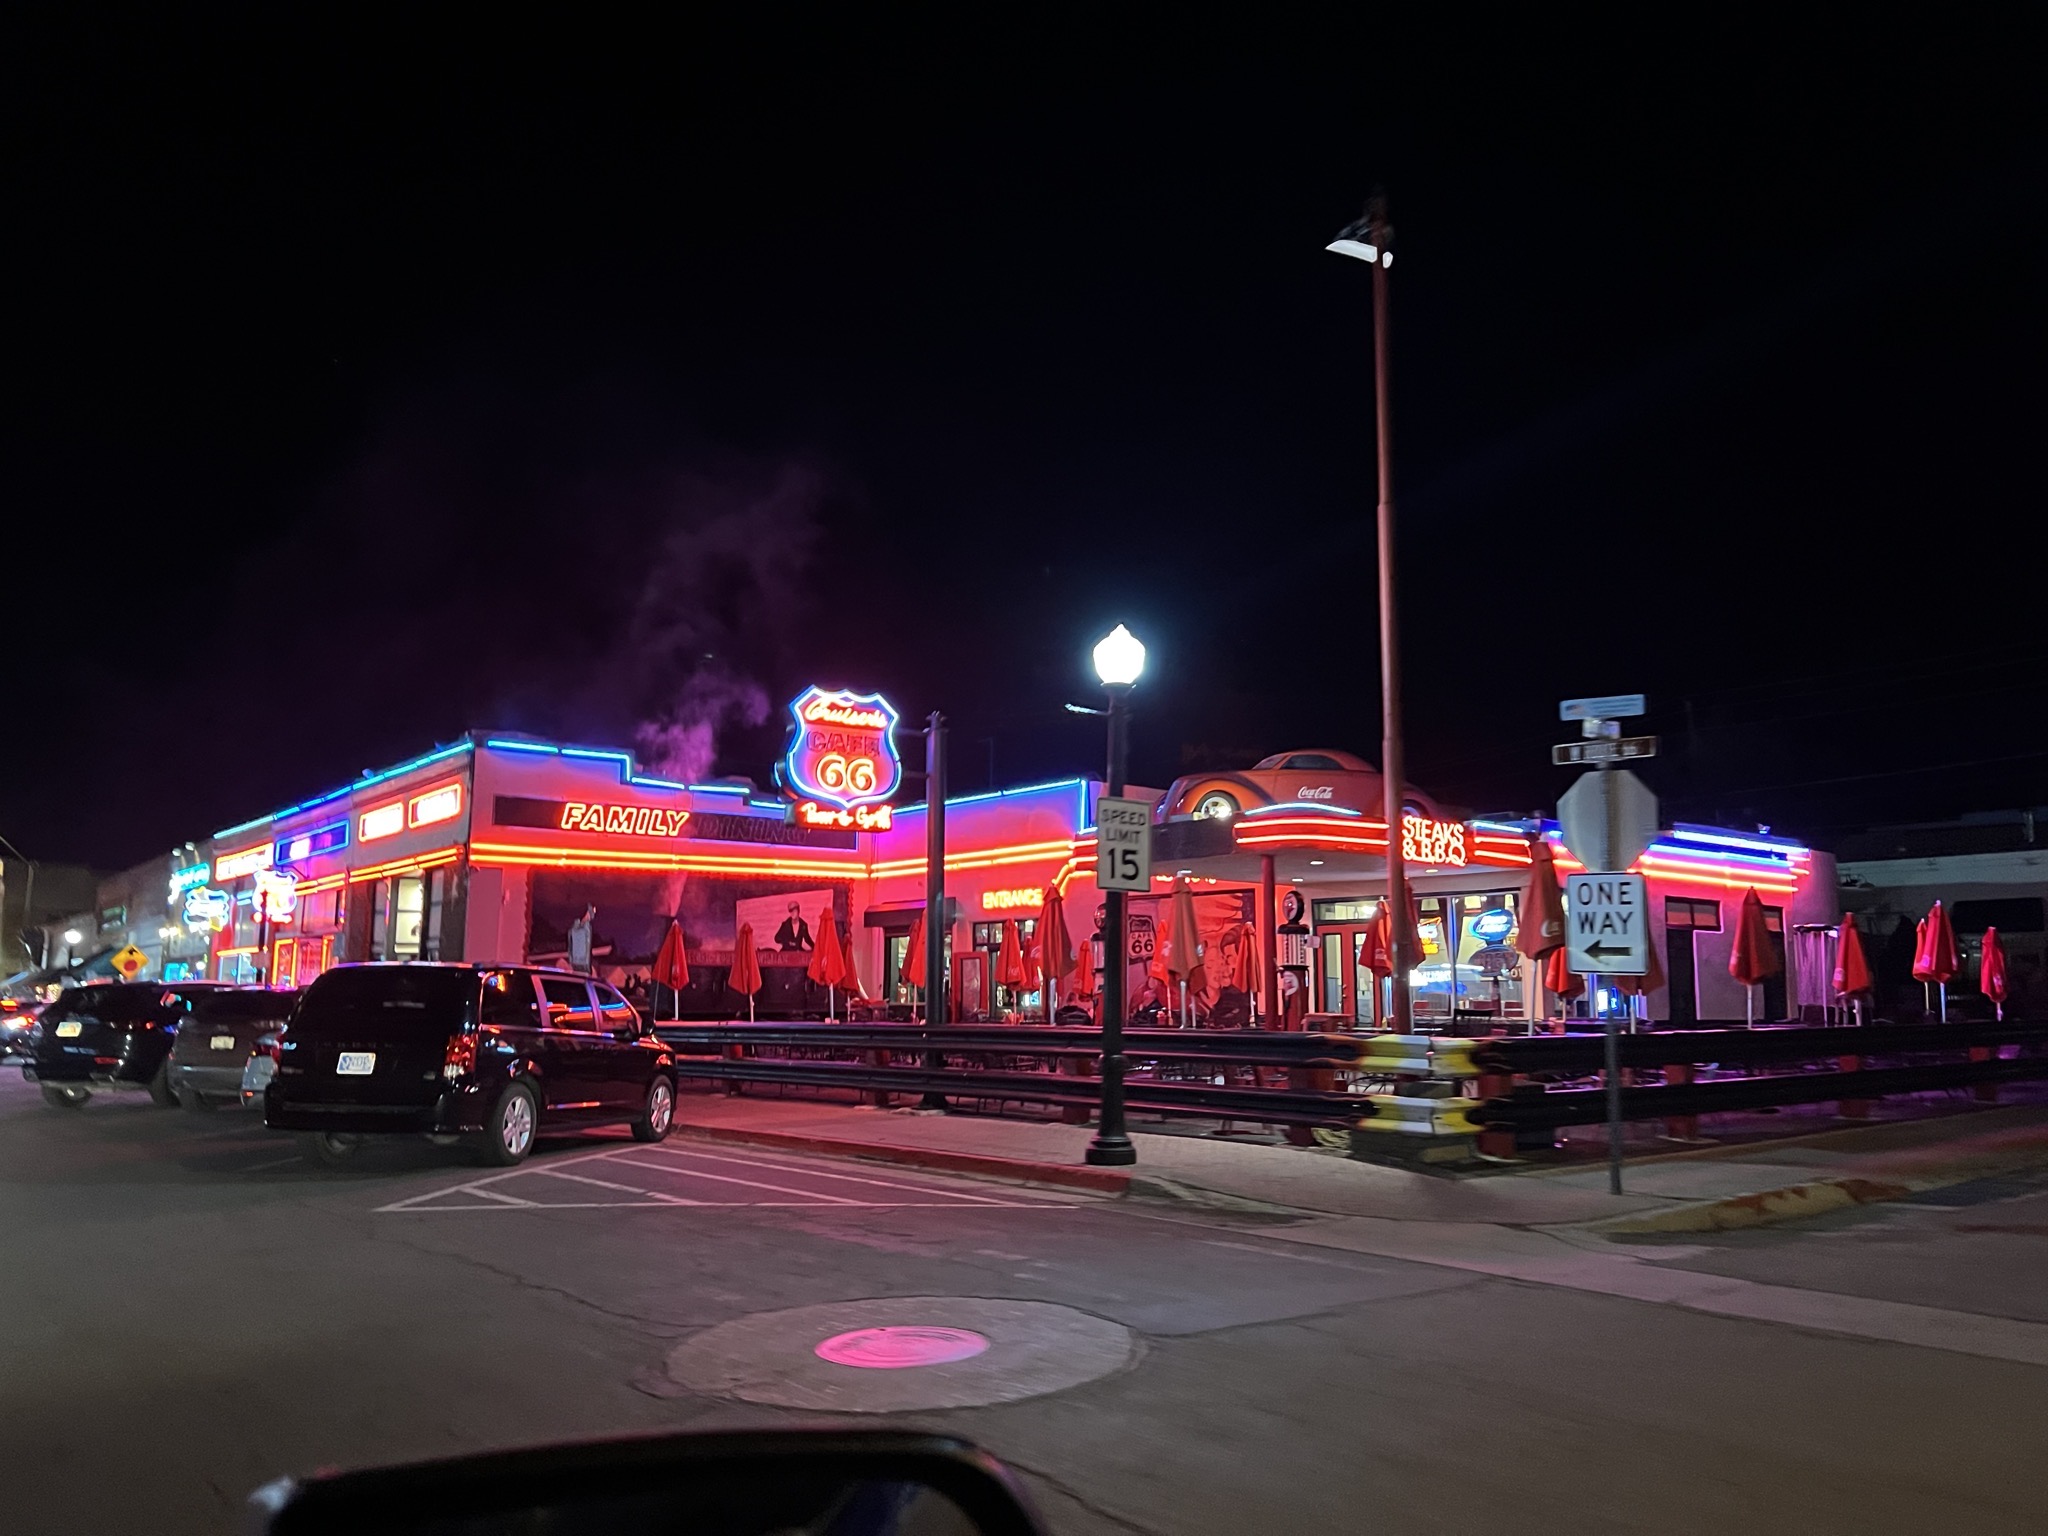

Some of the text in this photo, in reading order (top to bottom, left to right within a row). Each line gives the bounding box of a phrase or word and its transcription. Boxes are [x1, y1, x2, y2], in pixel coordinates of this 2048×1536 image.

[816, 754, 877, 796] 66
[560, 802, 690, 837] FAMILY
[856, 805, 892, 829] Grill
[1102, 809, 1146, 826] SPEED
[1106, 828, 1141, 843] LIMIT
[1402, 815, 1464, 846] STEAKS
[1108, 848, 1139, 881] 15
[983, 888, 1042, 909] ENTRANCE
[1577, 882, 1633, 905] ONE
[1577, 911, 1633, 935] WAY
[1132, 939, 1154, 954] 66
